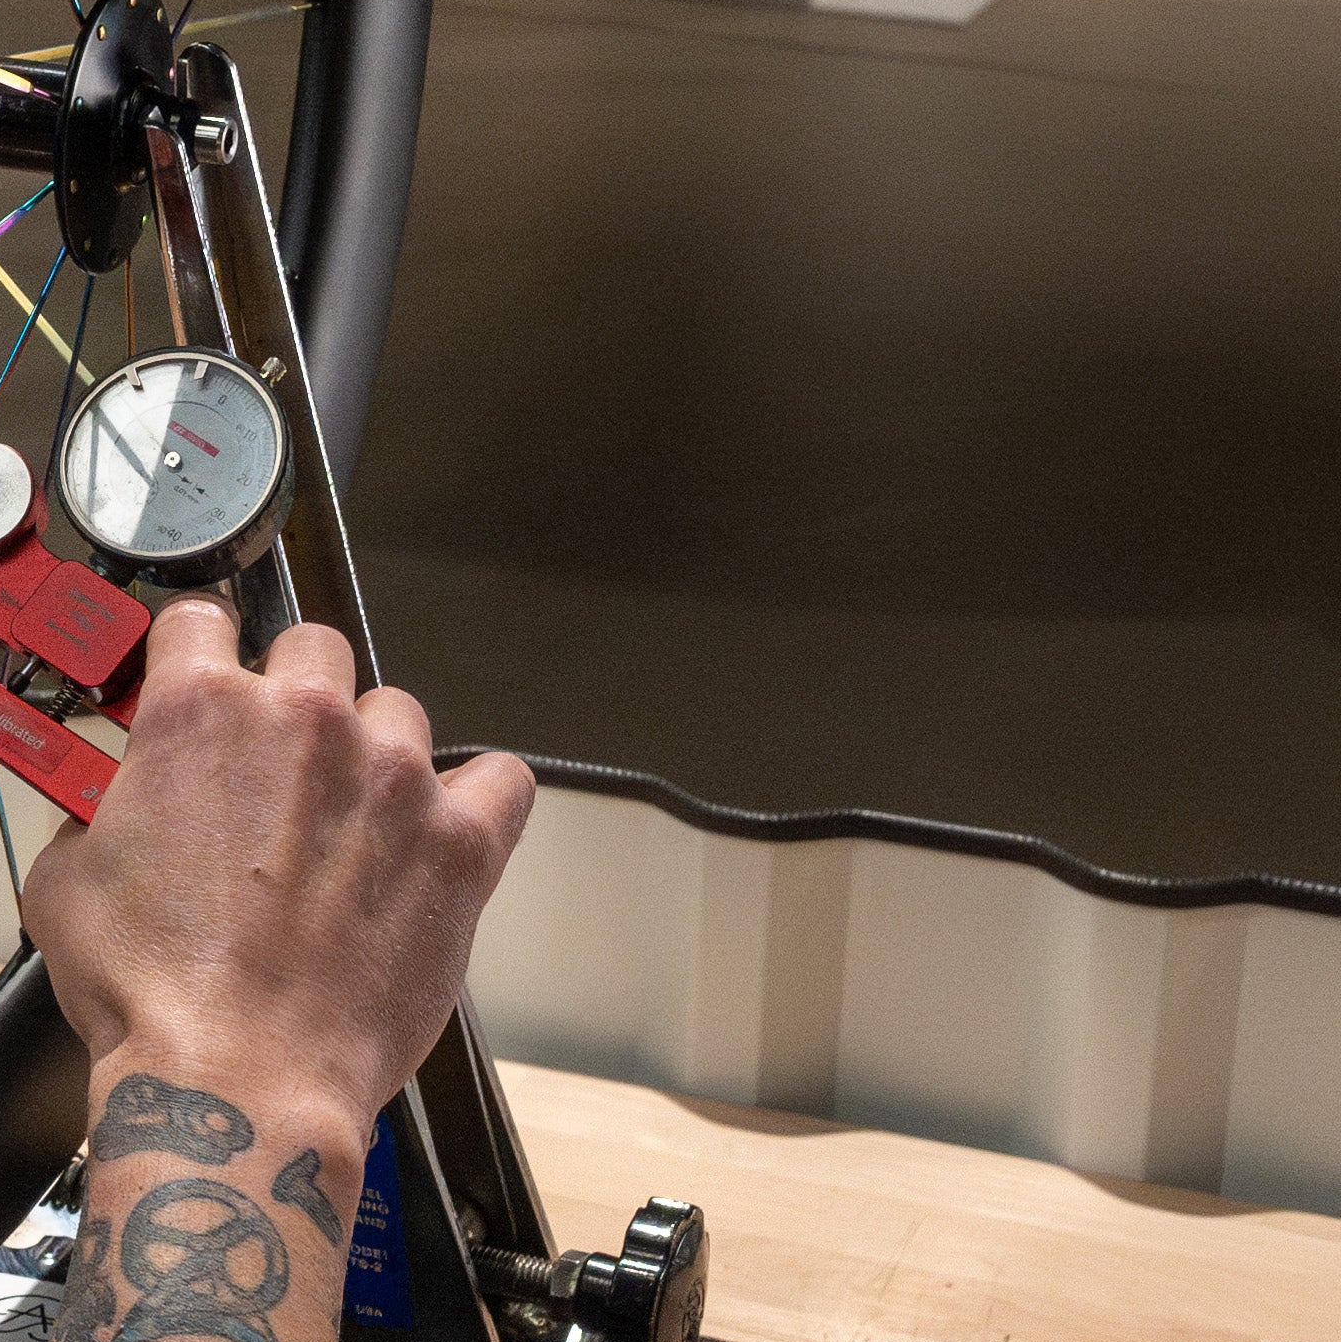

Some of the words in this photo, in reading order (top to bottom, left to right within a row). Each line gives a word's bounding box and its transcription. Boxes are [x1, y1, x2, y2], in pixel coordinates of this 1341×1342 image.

[218, 395, 228, 405] 0
[236, 473, 251, 486] 20
[210, 507, 226, 520] 30
[167, 528, 182, 541] 40
